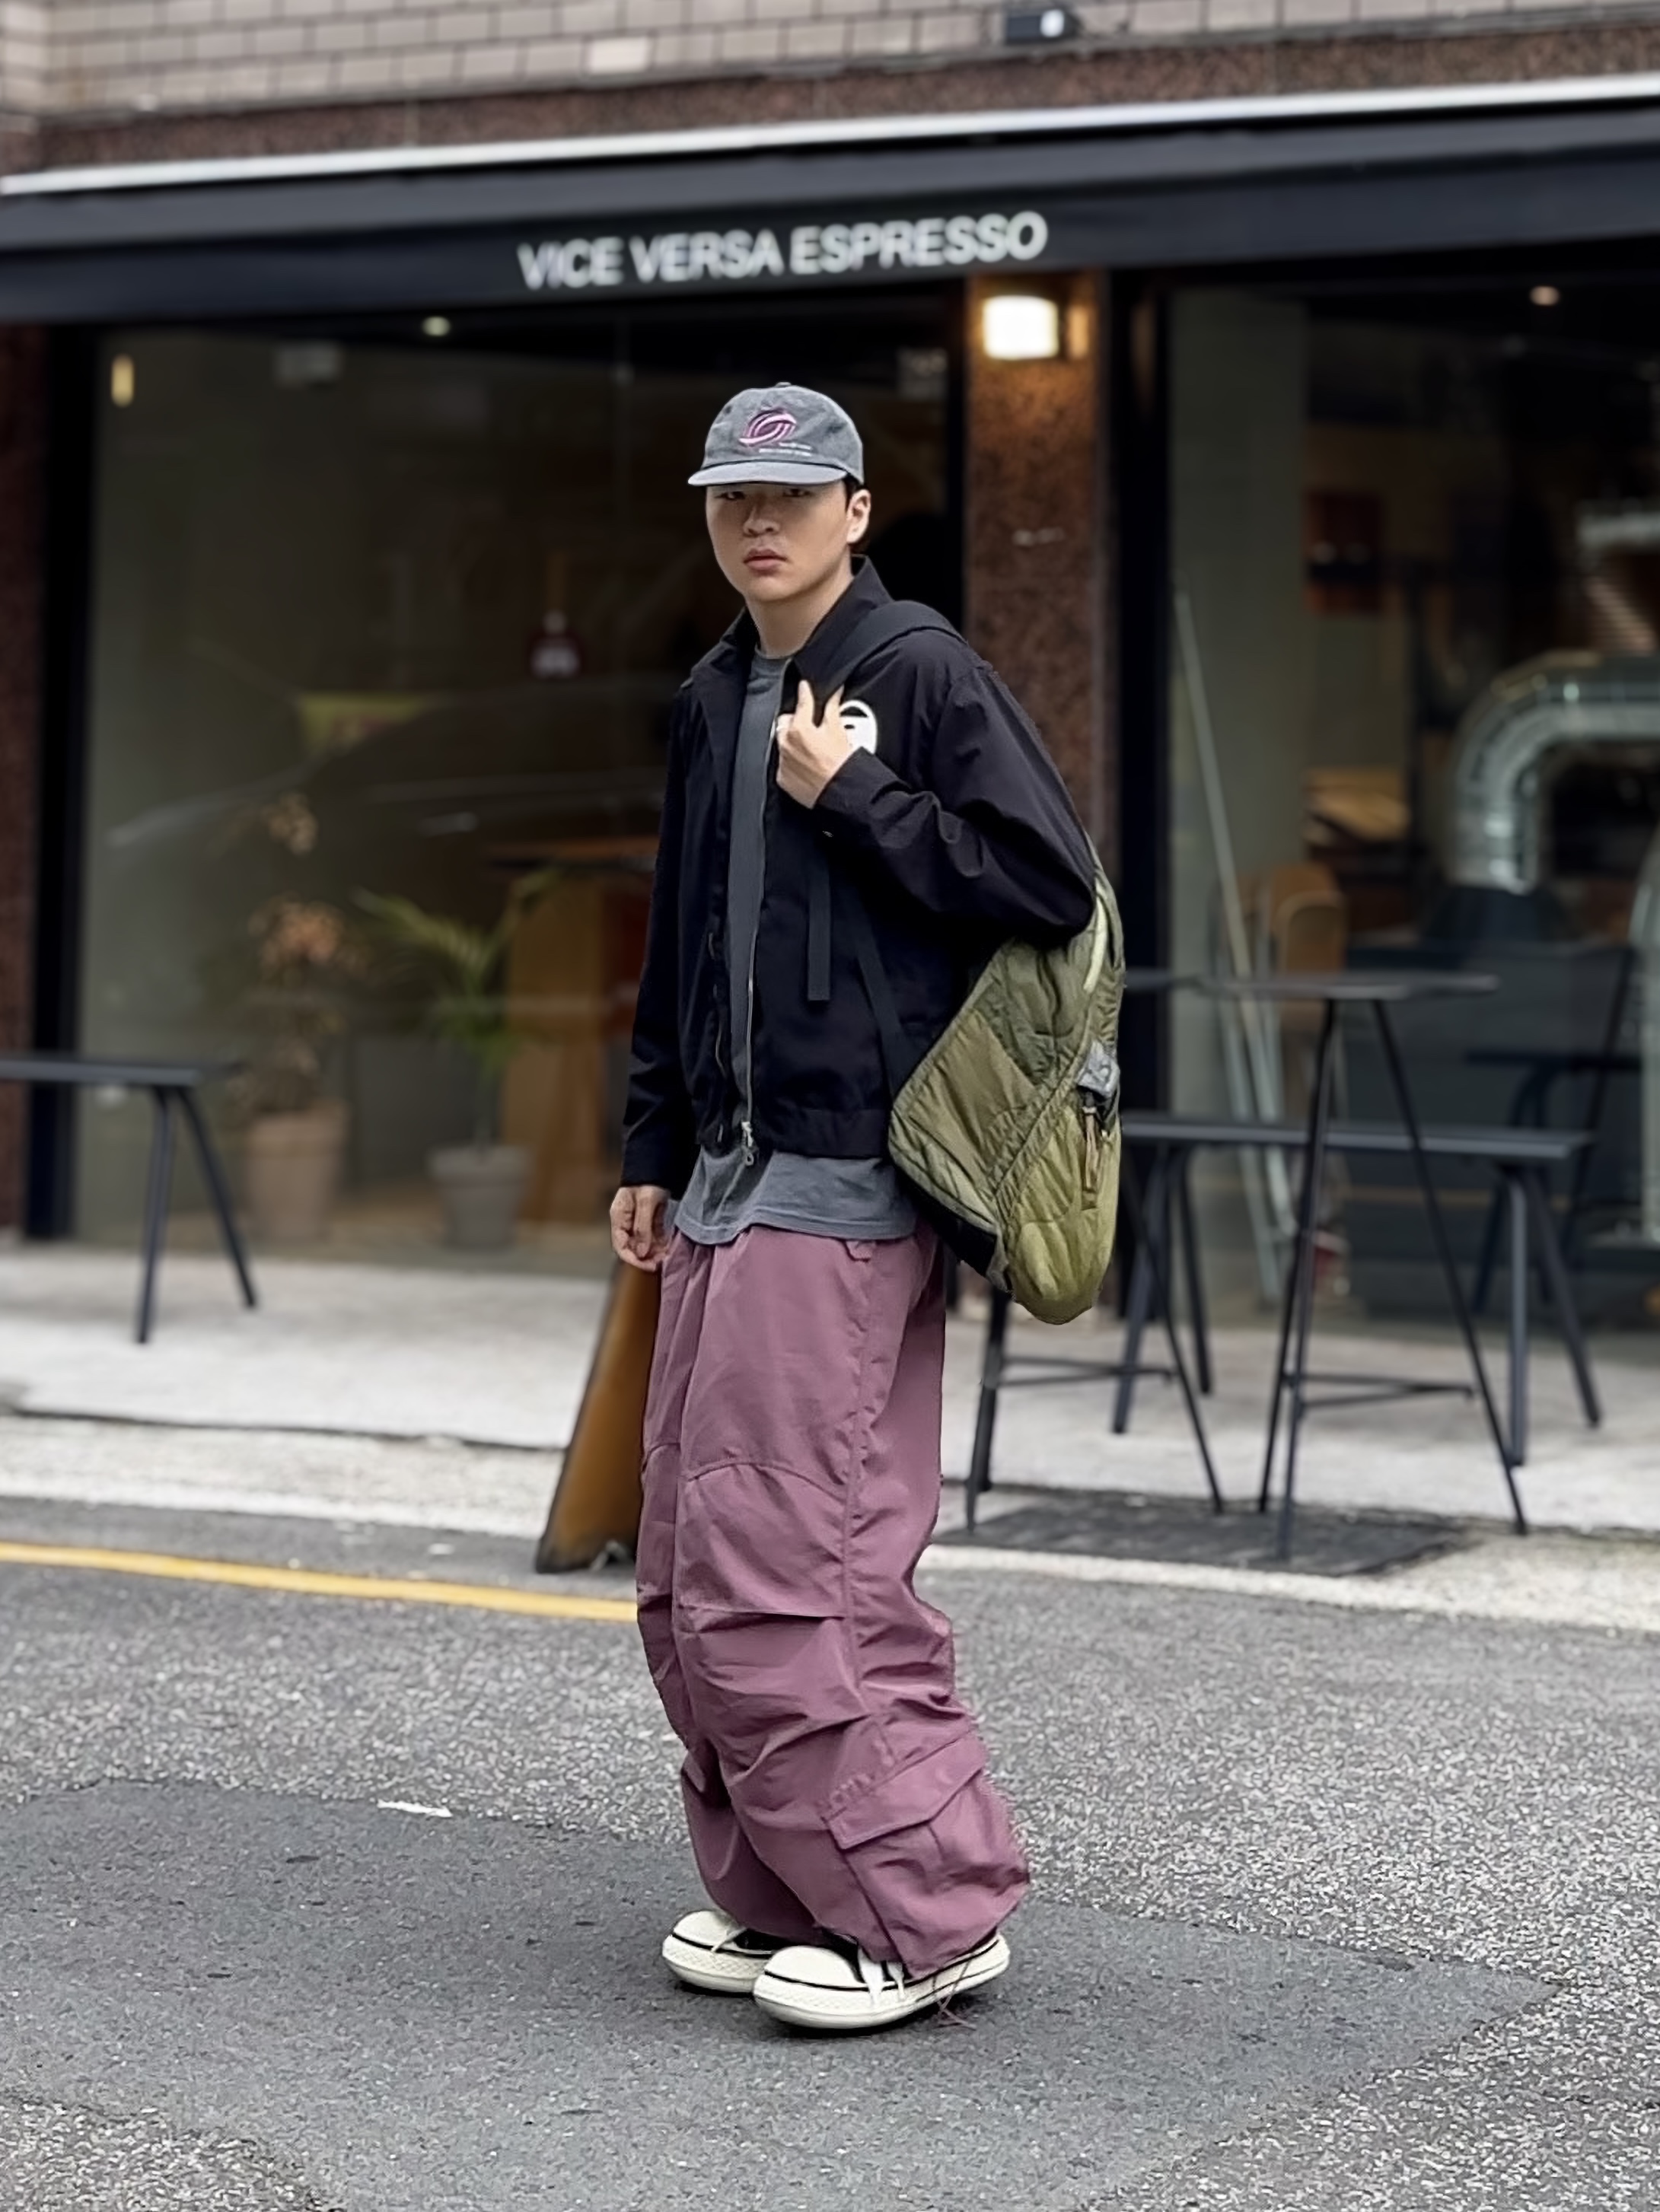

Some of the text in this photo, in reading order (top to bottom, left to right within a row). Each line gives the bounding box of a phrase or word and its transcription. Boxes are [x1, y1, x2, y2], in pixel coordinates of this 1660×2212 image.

[518, 211, 1048, 290] VICE VERSA ESPRESSO
